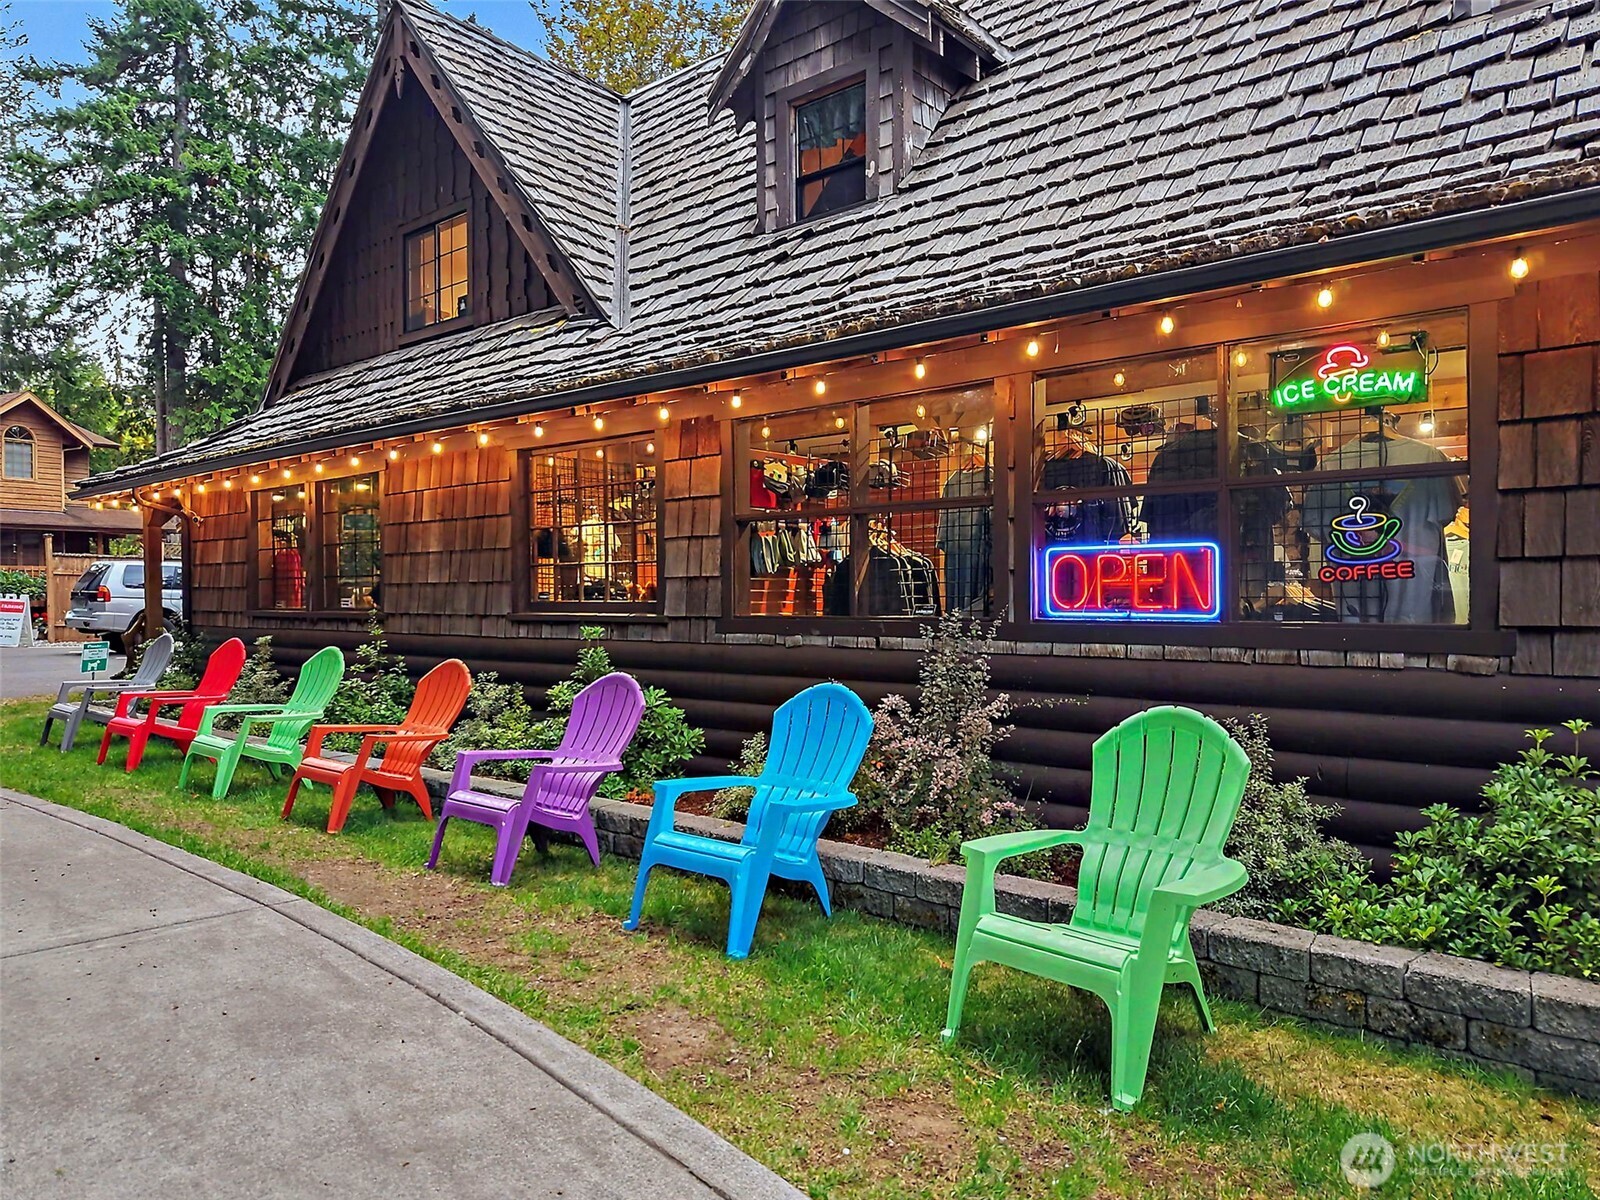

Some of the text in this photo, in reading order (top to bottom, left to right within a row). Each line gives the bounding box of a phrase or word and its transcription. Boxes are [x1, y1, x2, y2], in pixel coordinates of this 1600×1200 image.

[1276, 371, 1415, 406] ICE CREAM
[1052, 549, 1212, 609] OPEN
[1320, 562, 1413, 582] COFFEE
